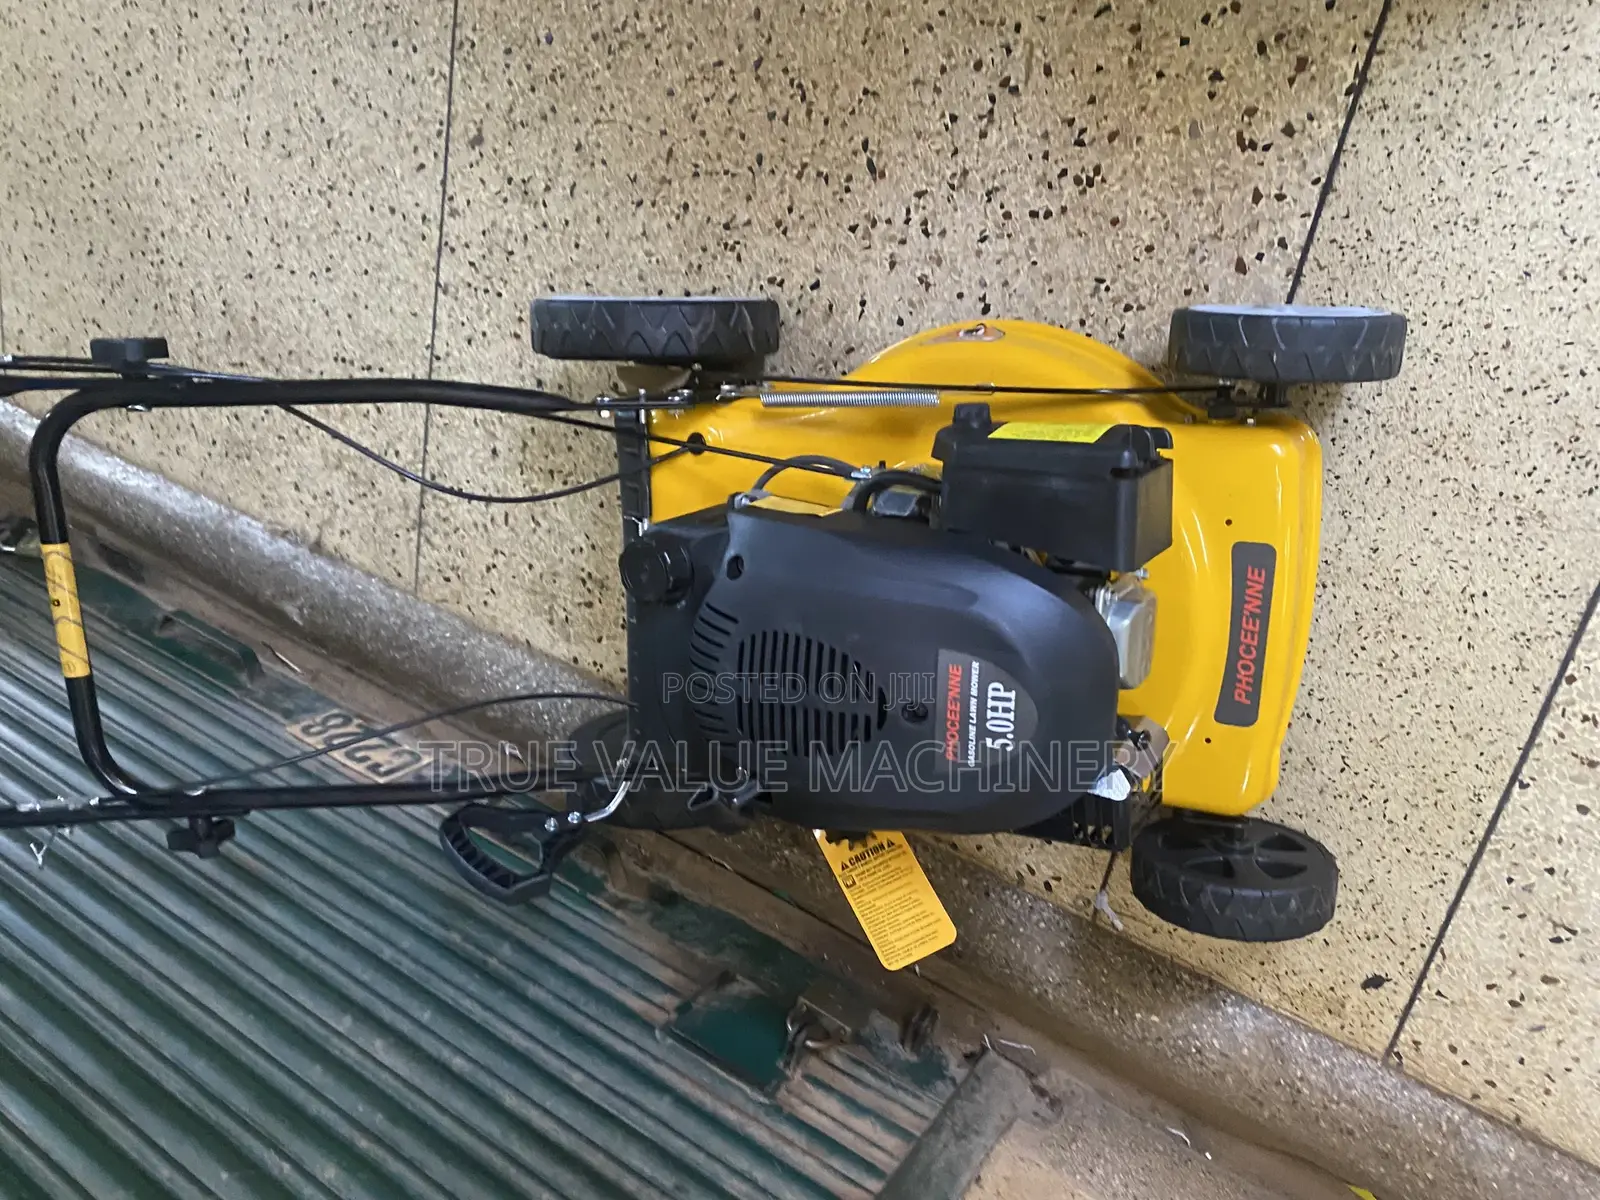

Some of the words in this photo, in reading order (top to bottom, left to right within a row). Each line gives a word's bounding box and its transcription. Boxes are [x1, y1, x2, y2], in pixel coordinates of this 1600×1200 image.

[1234, 565, 1266, 705] PHOCEE'NNE
[970, 660, 980, 697] MOWER
[969, 696, 978, 724] LAWN
[985, 681, 1016, 752] 5.0HP
[967, 724, 978, 768] GASOLINE
[848, 842, 886, 867] CAUTION
